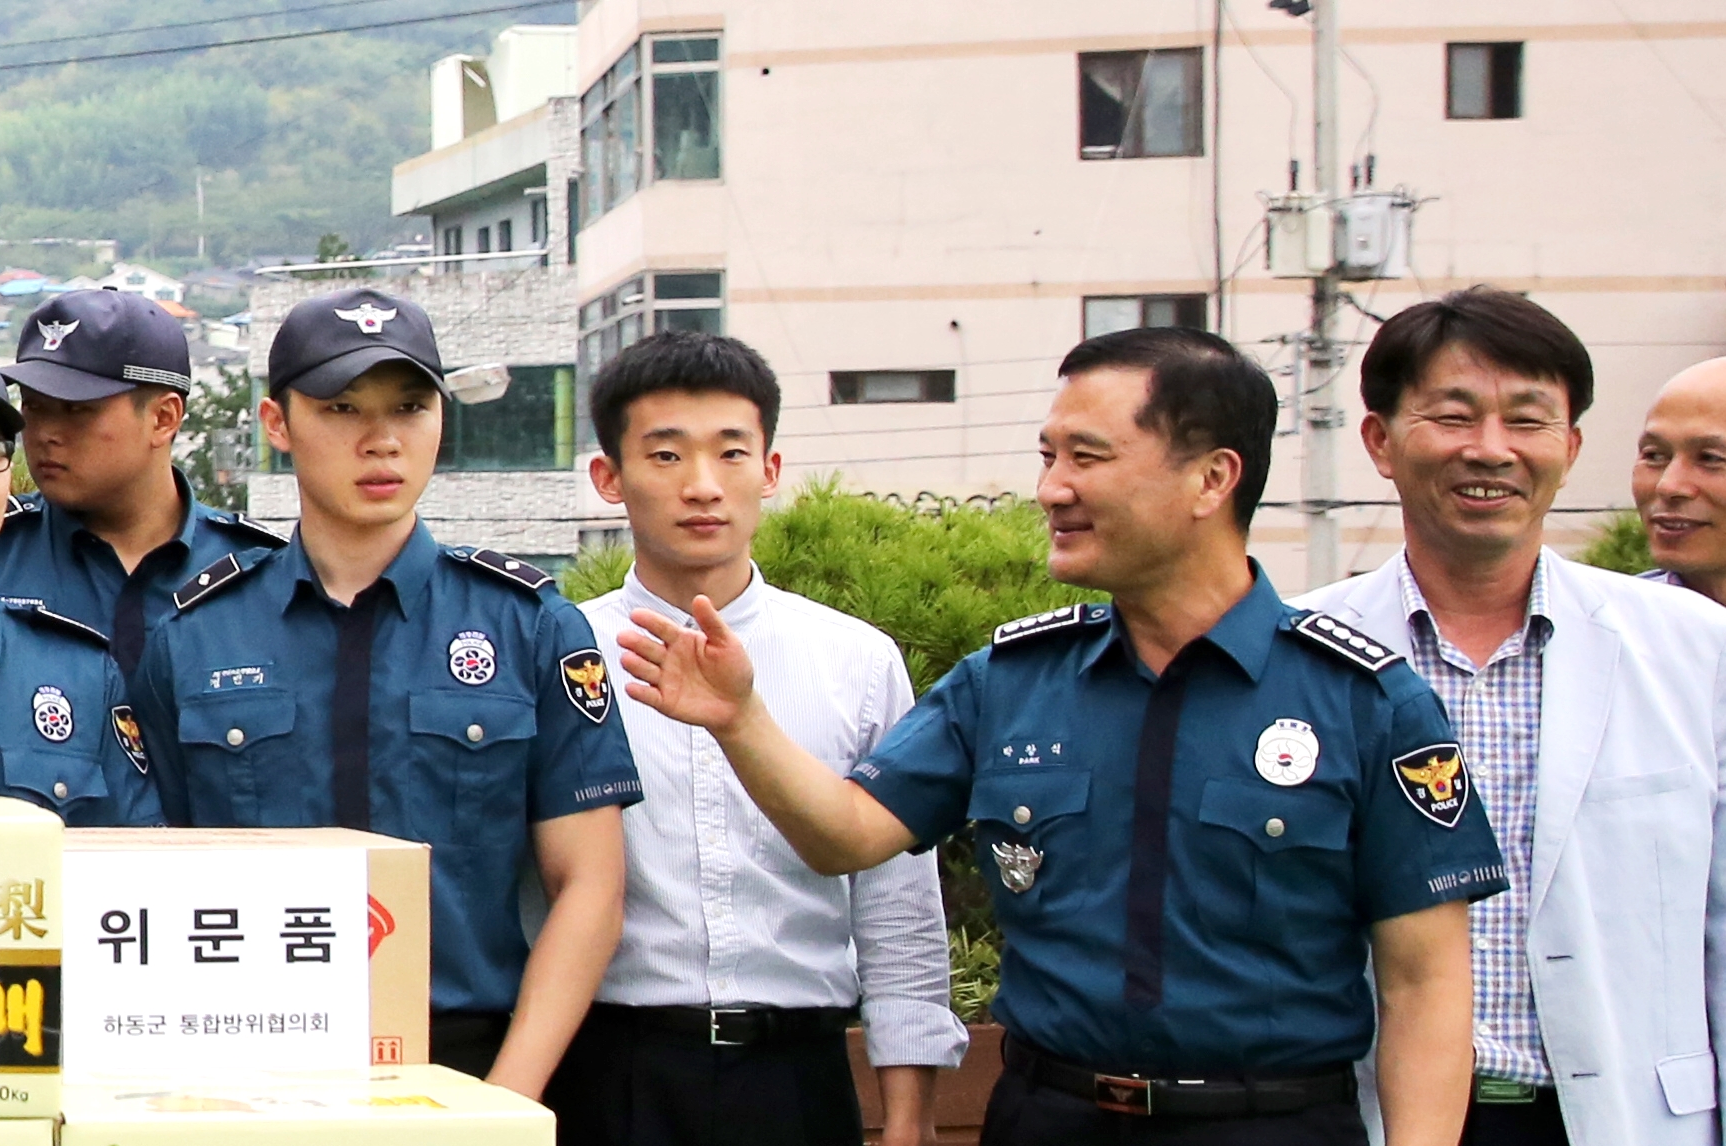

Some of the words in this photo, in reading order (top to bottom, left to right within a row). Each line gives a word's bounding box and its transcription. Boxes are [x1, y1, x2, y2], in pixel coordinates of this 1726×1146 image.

[585, 698, 605, 708] POLICE
[1430, 797, 1458, 813] POLICE
[103, 1015, 166, 1036] 하동군
[180, 1013, 329, 1035] 통합방위협의회
